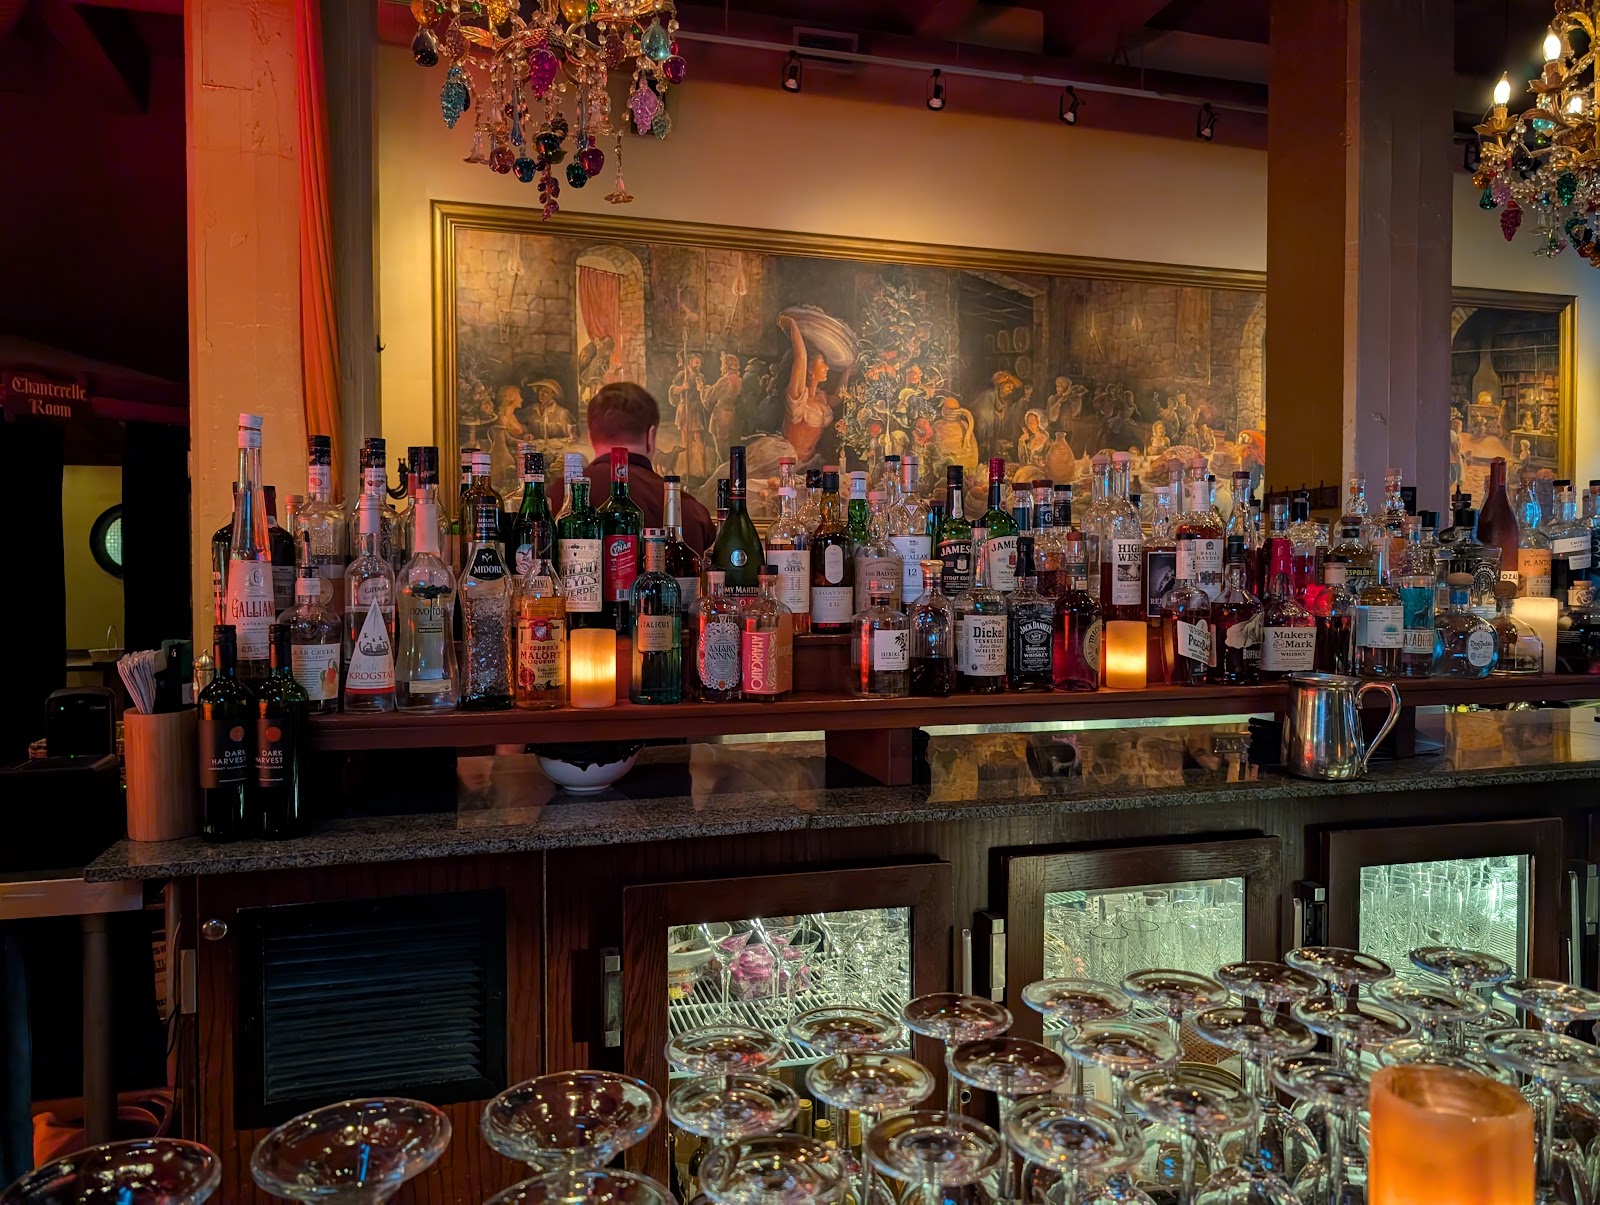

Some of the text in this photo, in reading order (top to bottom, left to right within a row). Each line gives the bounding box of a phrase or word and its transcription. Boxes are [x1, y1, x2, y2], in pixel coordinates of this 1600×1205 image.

[12, 376, 86, 401] Chanterelle
[29, 398, 72, 417] Room
[610, 541, 632, 557] CYNAR
[940, 544, 971, 557] JAMES
[473, 565, 503, 574] MIDORI
[907, 568, 918, 576] 12
[231, 598, 275, 619] GALLIAN
[432, 605, 445, 618] fog
[973, 626, 1005, 638] Dickel
[1020, 623, 1033, 635] JACK
[1273, 631, 1314, 639] Maker's
[708, 644, 736, 653] AMARO
[1285, 640, 1312, 648] Mark
[520, 650, 562, 660] MALÖRT
[225, 749, 246, 758] DARK
[262, 749, 283, 757] DARK
[211, 756, 247, 765] HARVEST
